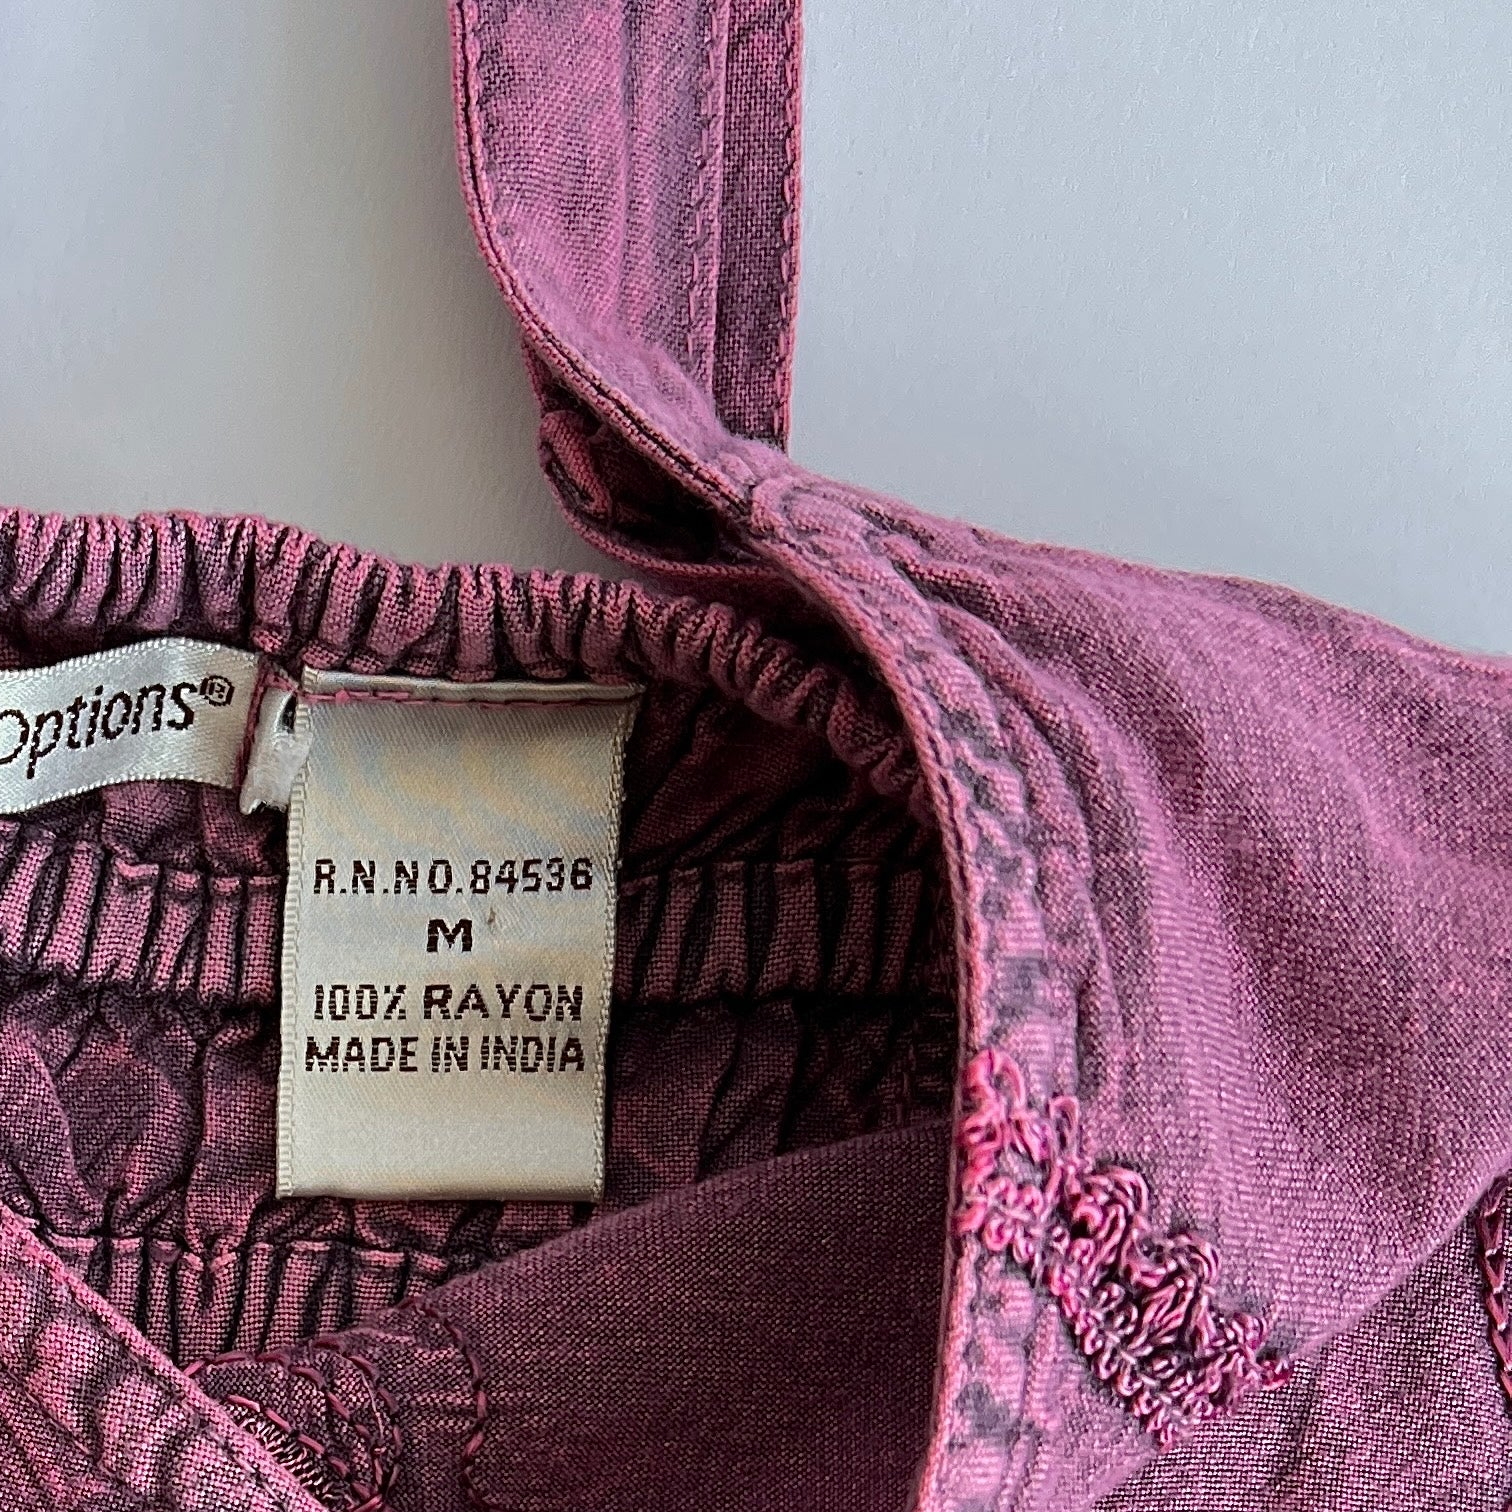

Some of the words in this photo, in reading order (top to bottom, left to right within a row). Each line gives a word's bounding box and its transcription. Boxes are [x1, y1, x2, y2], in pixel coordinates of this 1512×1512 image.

[426, 918, 473, 953] M
[314, 984, 407, 1021] 100%
[423, 984, 583, 1021] RAYON
[305, 1036, 419, 1073] MADE
[430, 1036, 469, 1073] IN
[480, 1036, 585, 1073] INDIA
